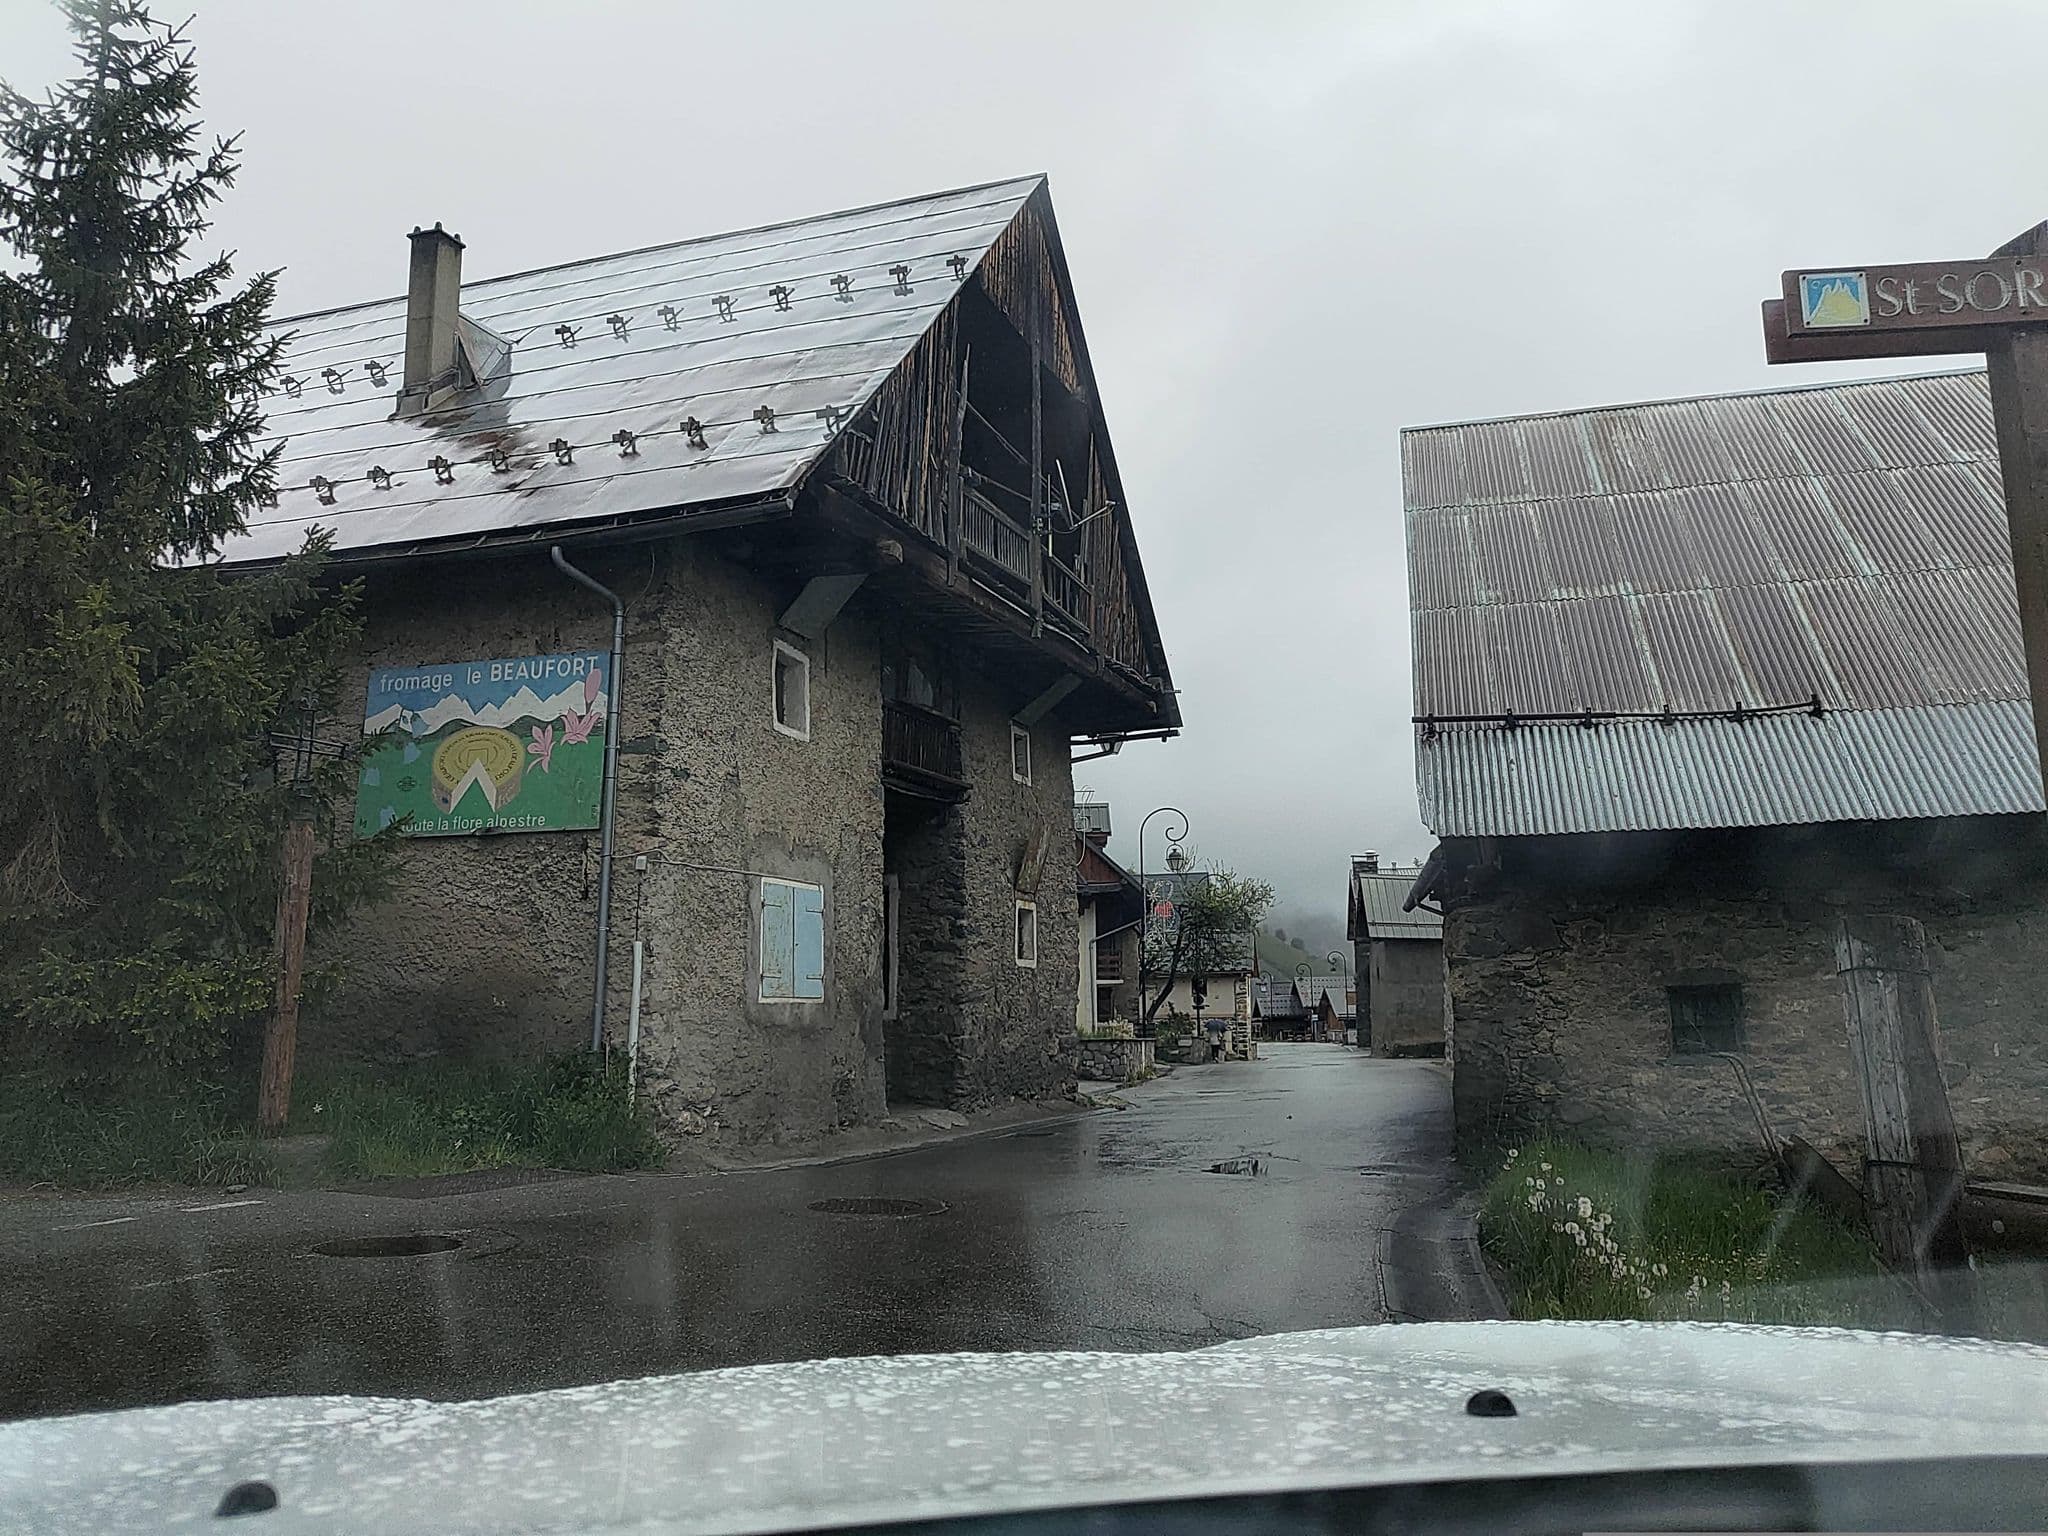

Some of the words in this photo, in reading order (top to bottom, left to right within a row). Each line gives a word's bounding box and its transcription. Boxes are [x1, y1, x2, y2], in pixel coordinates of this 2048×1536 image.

[1875, 277, 1922, 316] St
[1935, 269, 2048, 314] SOR
[379, 670, 453, 693] fromage
[467, 666, 482, 685] le
[490, 655, 599, 683] BEAUFORT
[437, 817, 449, 831] la
[452, 815, 483, 830] flore
